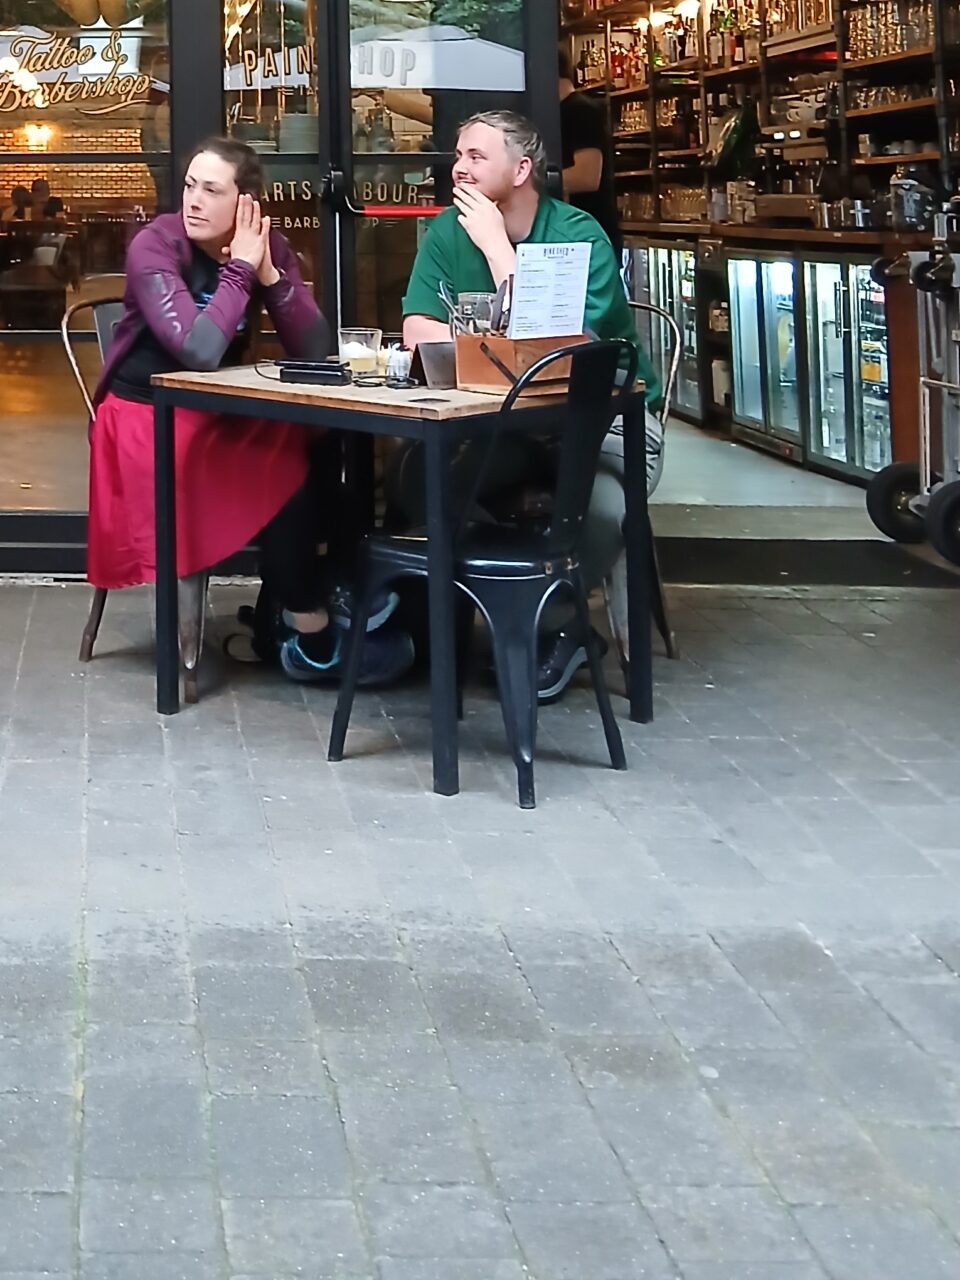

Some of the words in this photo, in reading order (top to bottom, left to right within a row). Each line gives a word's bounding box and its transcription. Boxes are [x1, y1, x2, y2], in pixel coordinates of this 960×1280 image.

[10, 31, 96, 74] Tattoo
[100, 30, 123, 62] &
[243, 44, 313, 87] PAIN
[358, 44, 417, 87] HOP
